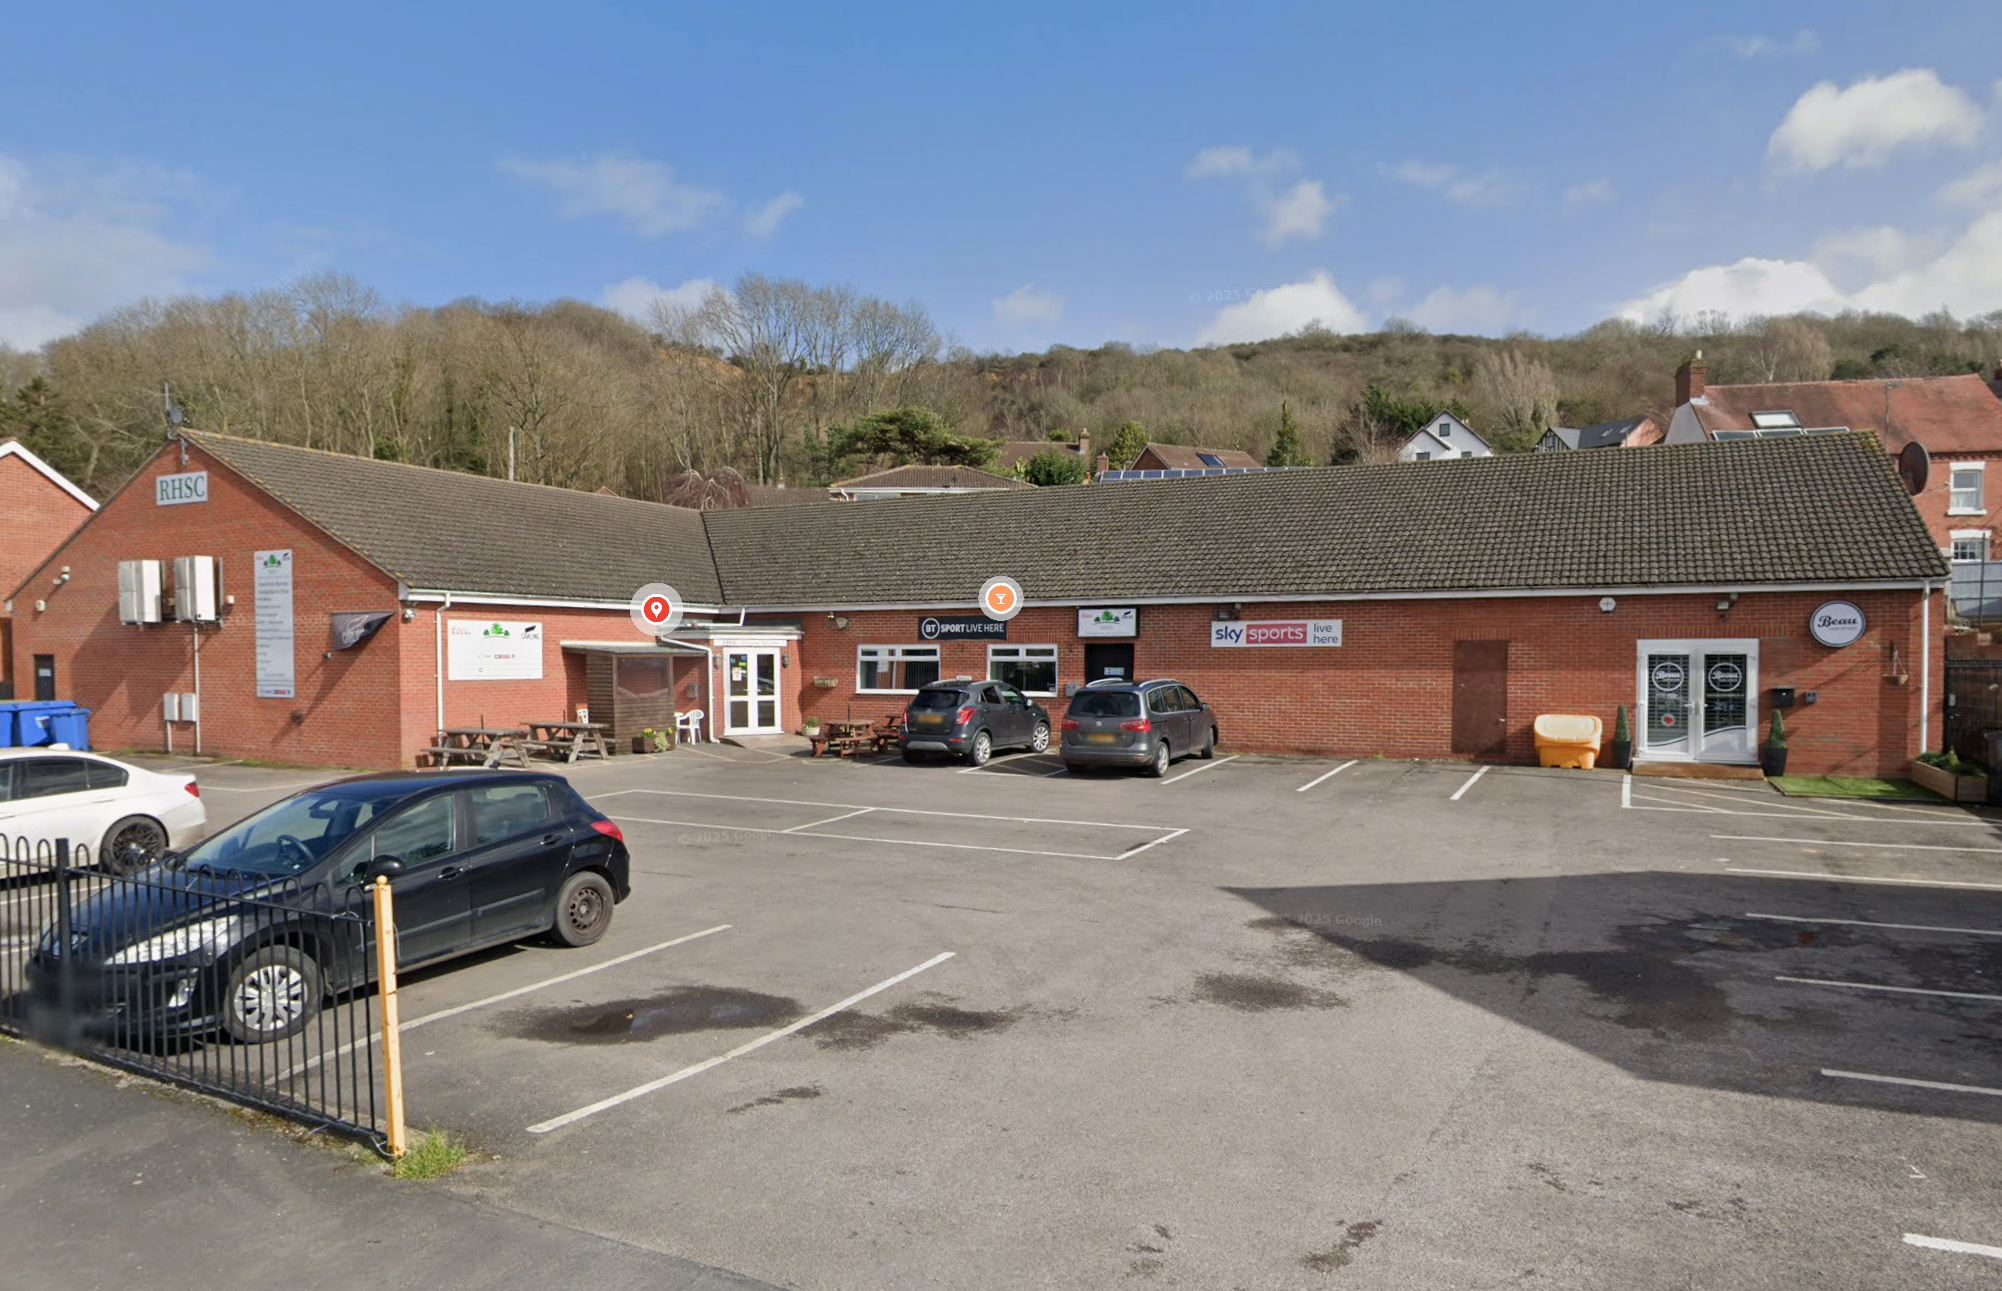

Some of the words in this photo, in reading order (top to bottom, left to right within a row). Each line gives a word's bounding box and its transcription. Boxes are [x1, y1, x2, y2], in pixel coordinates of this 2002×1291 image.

[159, 475, 205, 501] RHSC
[1817, 615, 1858, 628] Beau
[925, 624, 936, 633] BT
[940, 624, 965, 633] SPORT
[966, 623, 983, 633] LIVE
[983, 623, 1004, 632] HERE
[1313, 623, 1333, 633] live
[1215, 625, 1243, 643] sky
[1249, 626, 1304, 643] sports
[1313, 634, 1339, 644] here
[1655, 670, 1681, 680] Beau
[1712, 670, 1739, 680] Beau
